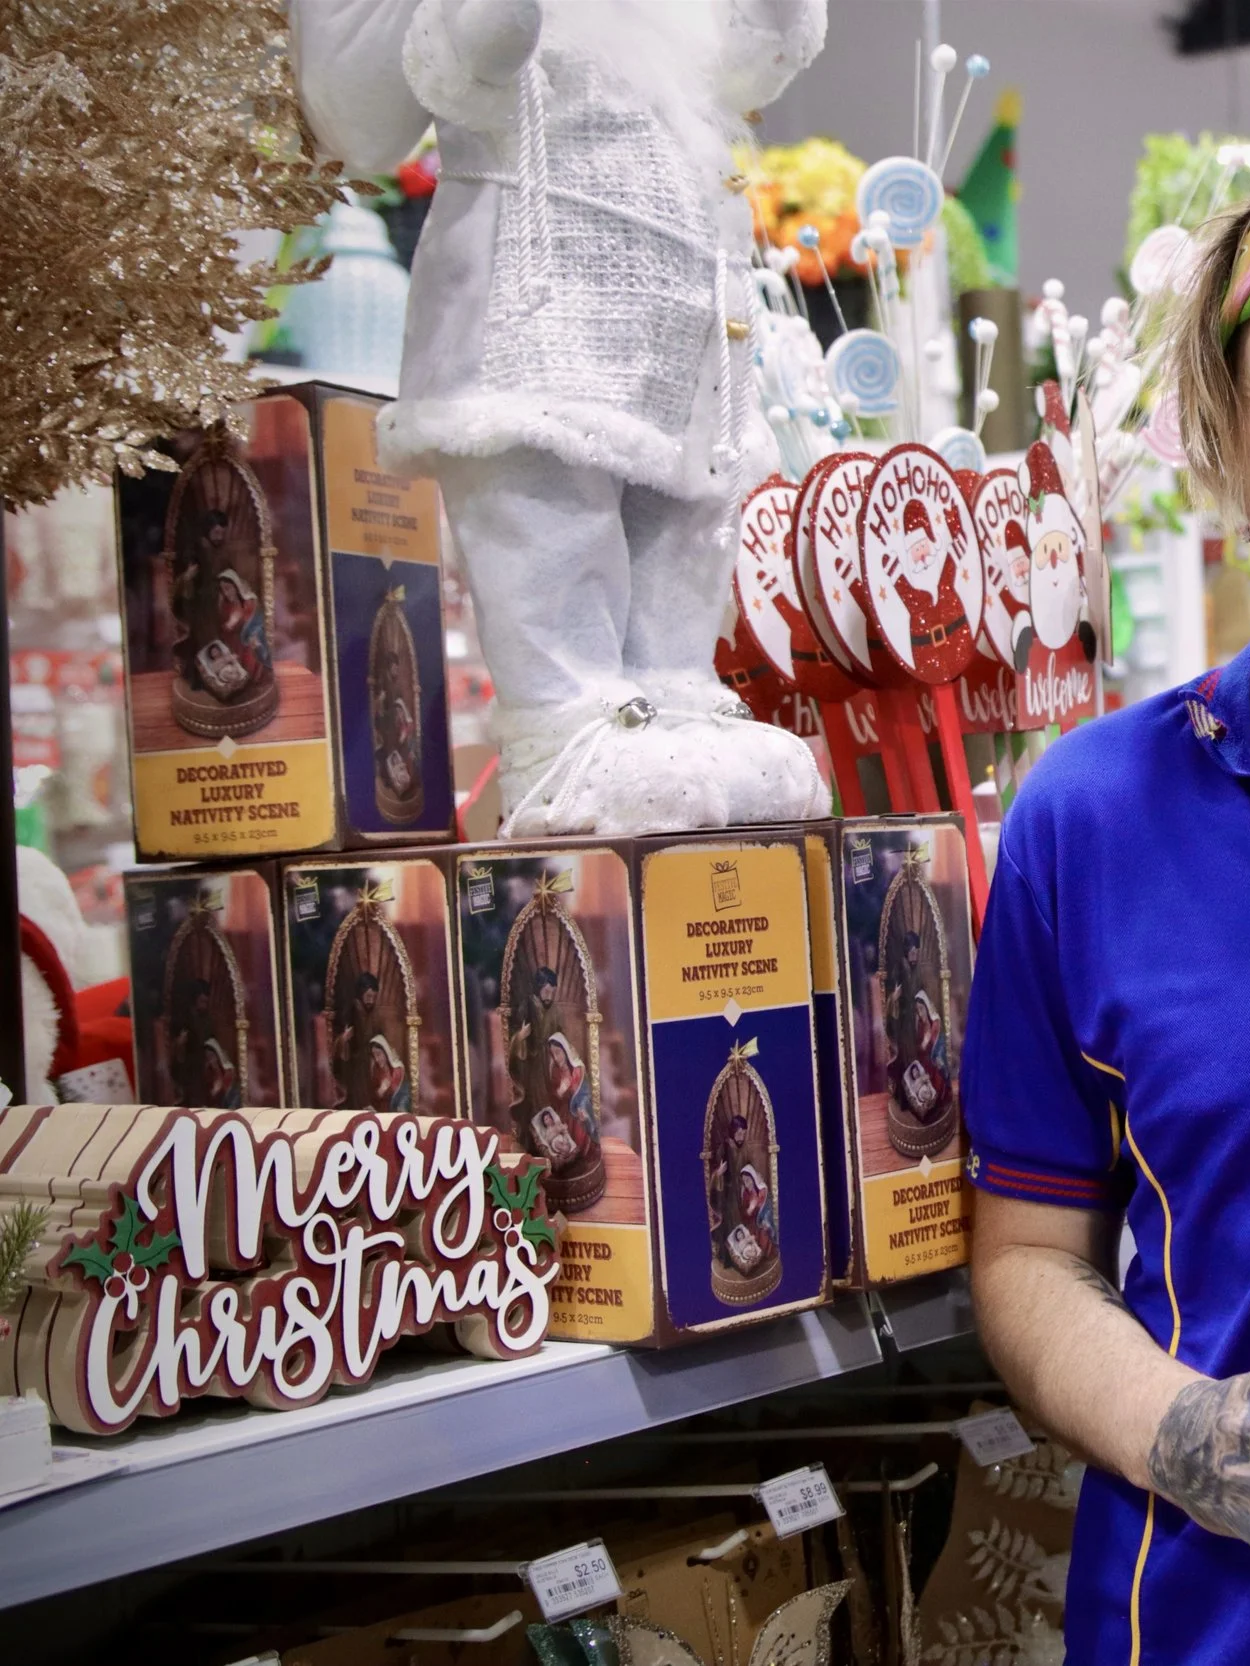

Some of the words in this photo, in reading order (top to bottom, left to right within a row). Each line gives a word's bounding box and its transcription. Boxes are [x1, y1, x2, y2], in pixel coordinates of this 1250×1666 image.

[868, 456, 951, 546] HOHOHO
[176, 760, 287, 784] DECORATIVED
[200, 783, 265, 803] LUXURY
[170, 805, 244, 826] NATIVITY
[248, 802, 300, 821] SCENE
[686, 916, 769, 938] DECORATIVED
[705, 939, 754, 958] LUXURY
[682, 962, 739, 983] NATIVITY
[741, 958, 778, 976] SCENE
[699, 990, 712, 1001] 9.5
[720, 988, 733, 999] 9.5
[742, 985, 764, 996] 23cm
[136, 1115, 498, 1280] Merry
[909, 1200, 950, 1224] LUXURY
[889, 1223, 938, 1250] NATIVITY
[577, 1287, 624, 1307] SCENE
[87, 1212, 559, 1425] Christmas
[553, 1311, 568, 1323] 9.5
[577, 1313, 604, 1325] 23cm
[799, 1482, 827, 1500] $8.99
[574, 1558, 607, 1578] $2.50
